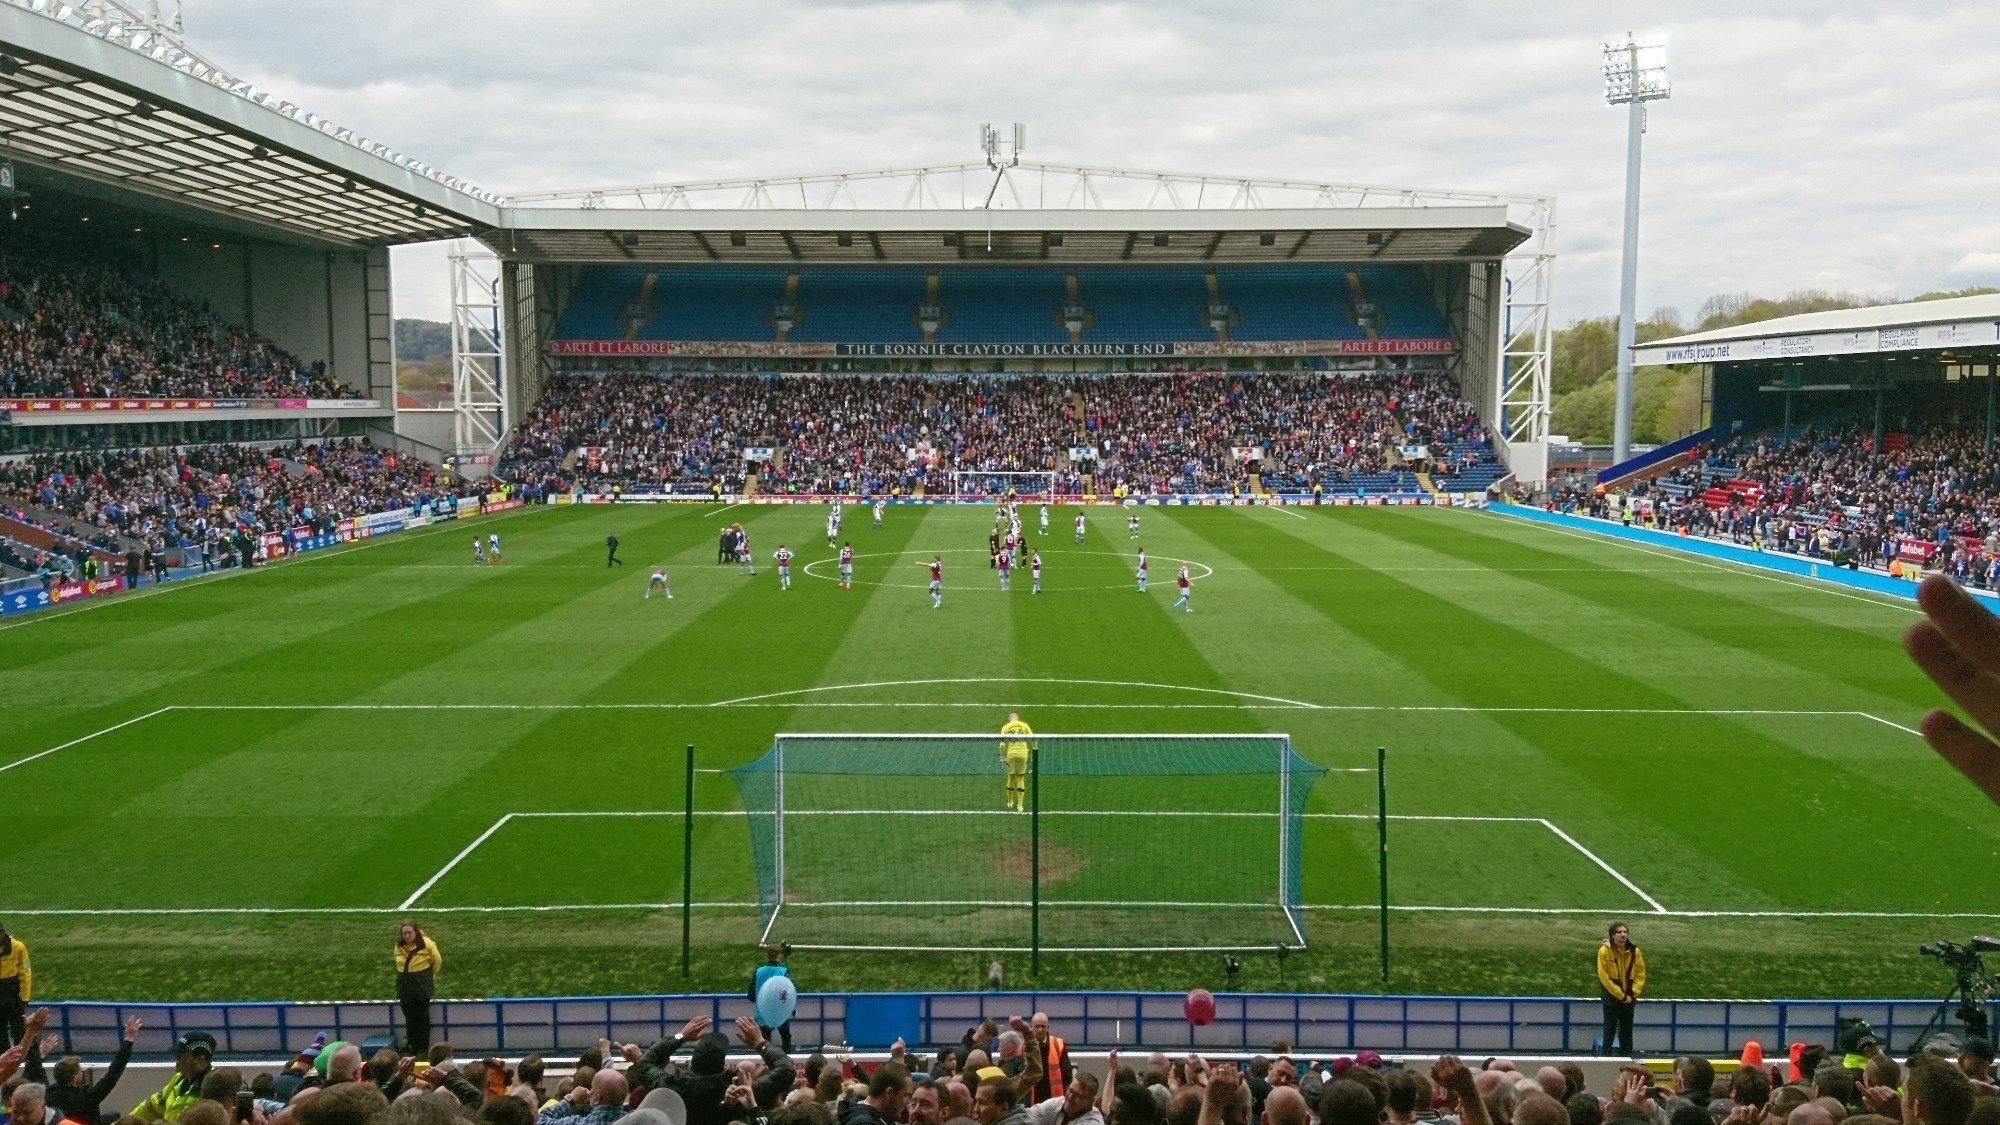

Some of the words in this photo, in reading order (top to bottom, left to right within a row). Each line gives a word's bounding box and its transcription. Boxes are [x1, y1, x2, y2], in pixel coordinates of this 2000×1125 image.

[1881, 328, 1919, 338] REGULATORY
[563, 342, 595, 353] ARTE
[600, 342, 616, 353] ET
[618, 342, 666, 353] LABORE
[1343, 341, 1374, 352] ARTE
[1378, 341, 1393, 351] ET
[1395, 340, 1441, 351] LABORE
[1780, 337, 1812, 347] REGULATORY
[1881, 337, 1919, 348] COMPLIANCE
[846, 344, 876, 355] THE
[884, 344, 946, 355] RONNIE
[953, 344, 1025, 355] CLAYTON
[1033, 344, 1125, 355] BLACKBURN
[1134, 344, 1166, 354] END
[475, 456, 490, 464] BET
[1900, 542, 1925, 556] dafabet
[780, 552, 788, 560] 22
